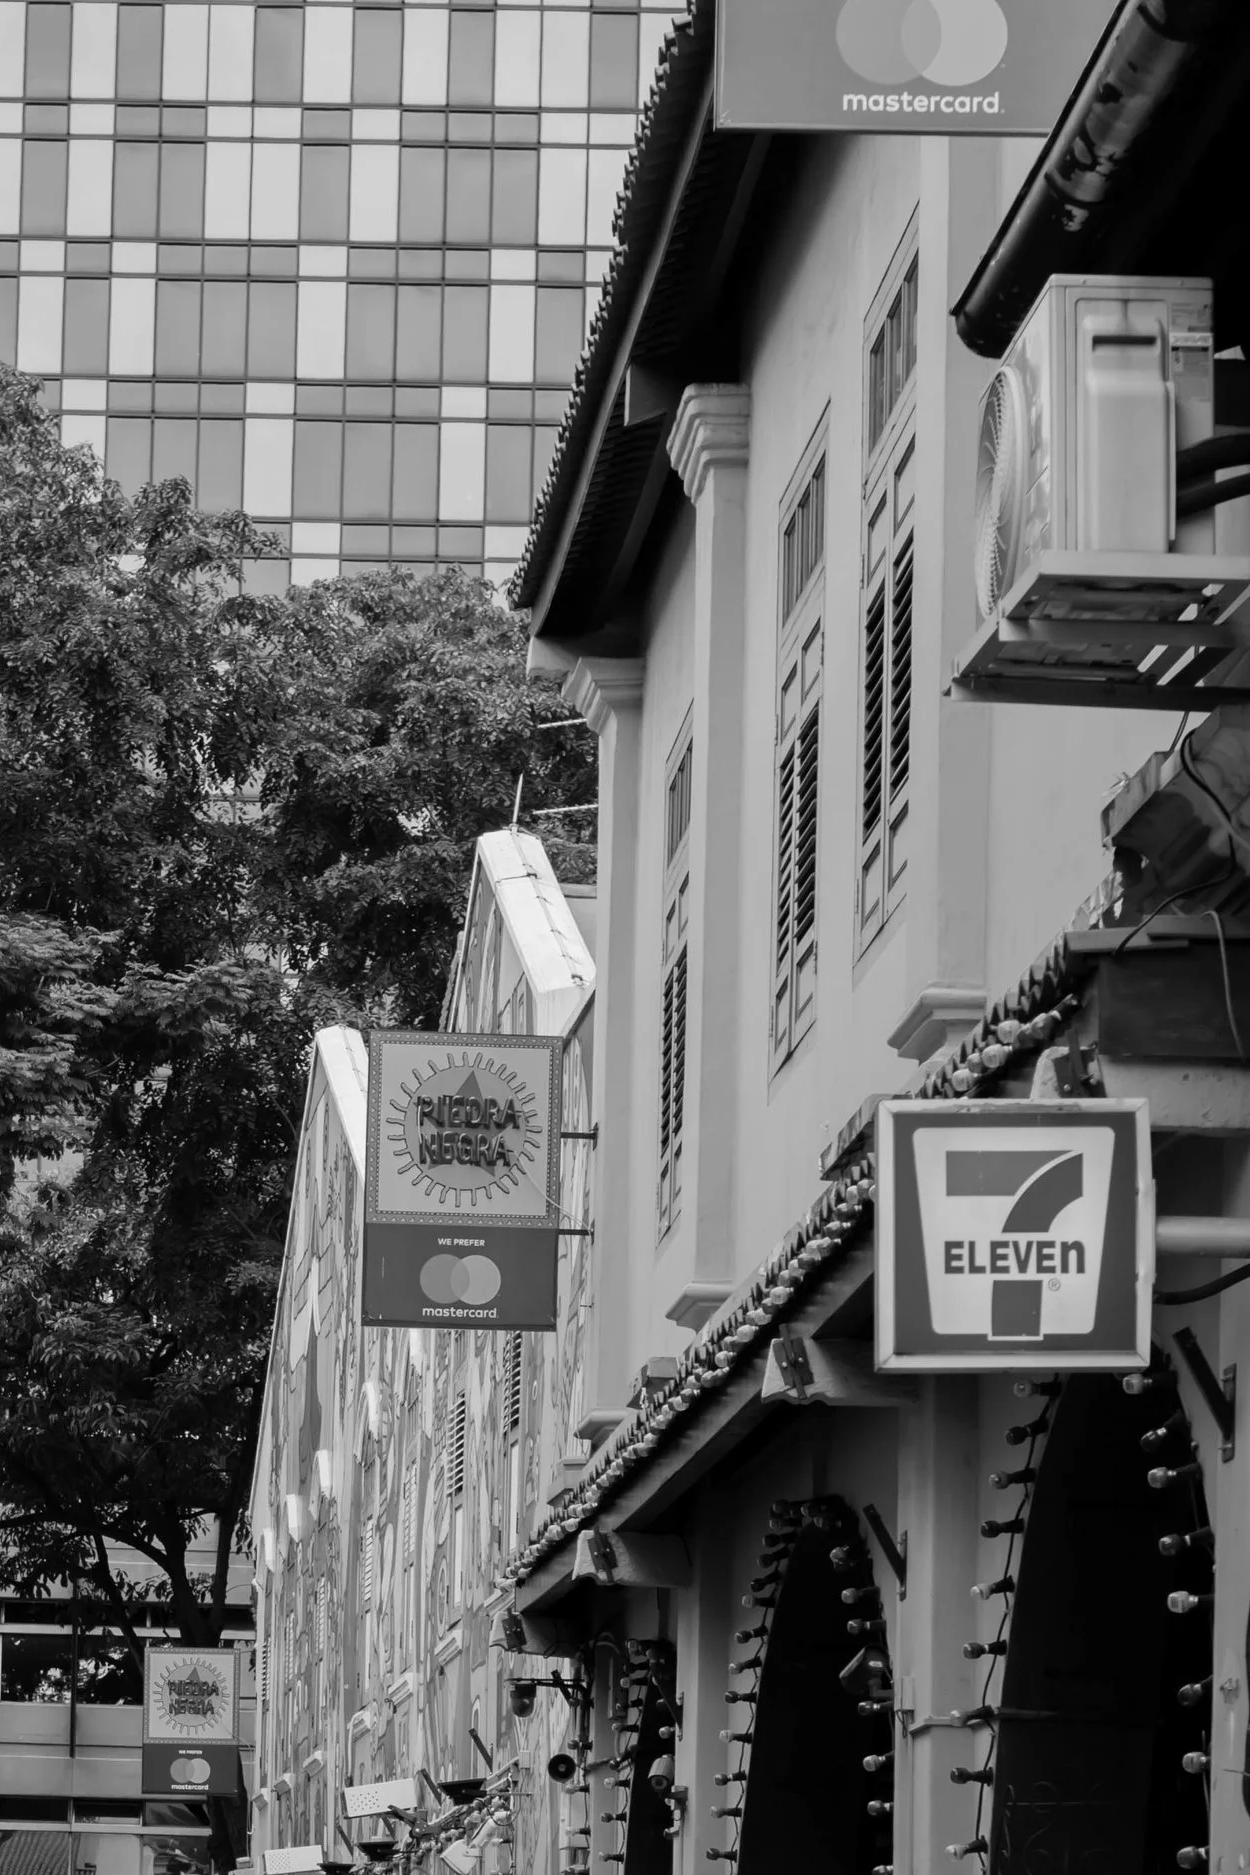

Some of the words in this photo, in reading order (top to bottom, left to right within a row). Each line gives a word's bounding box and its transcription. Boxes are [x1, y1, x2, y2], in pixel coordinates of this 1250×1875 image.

[842, 91, 1000, 114] mastercard
[416, 1095, 521, 1129] PIEDRA
[418, 1131, 513, 1167] NEGRA
[437, 1237, 452, 1247] WE
[453, 1238, 486, 1247] PREFER
[422, 1305, 497, 1319] mastercard
